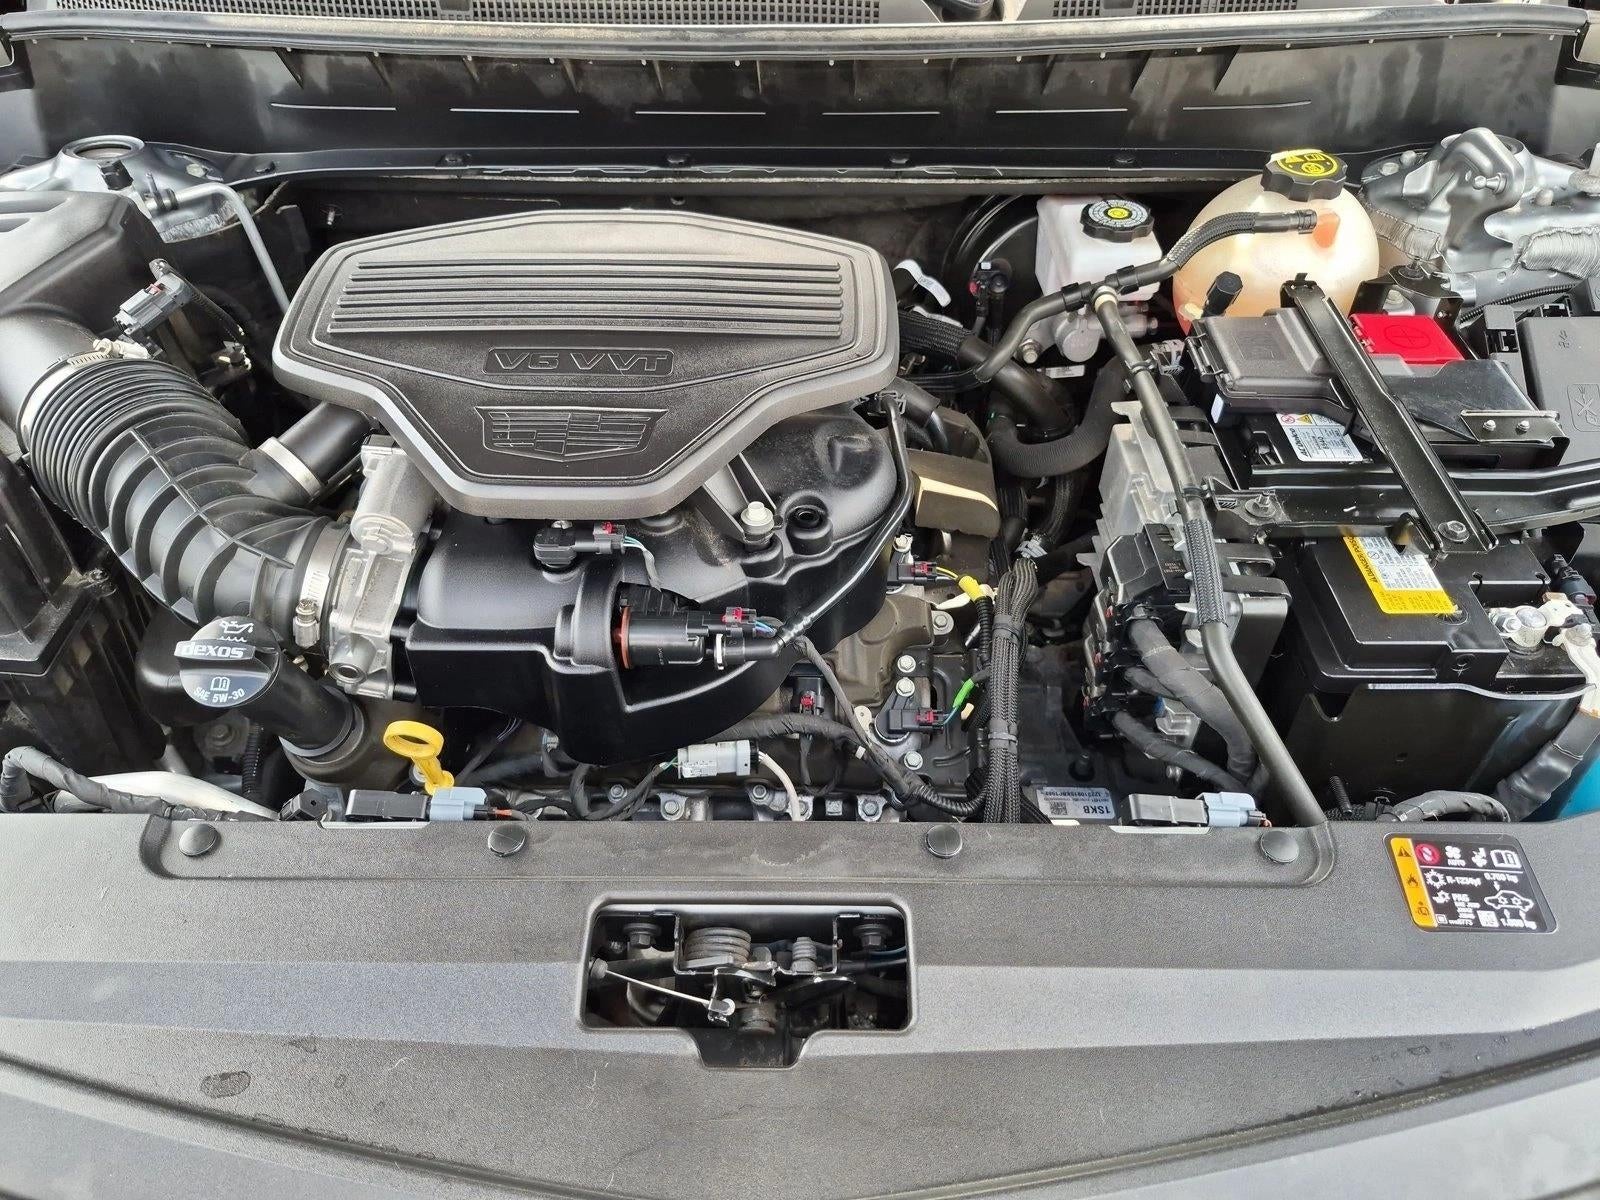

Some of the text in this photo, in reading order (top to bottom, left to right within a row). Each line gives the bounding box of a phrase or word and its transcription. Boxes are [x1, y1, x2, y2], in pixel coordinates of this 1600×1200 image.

[494, 352, 668, 372] V6 VVT
[181, 641, 247, 658] dexos
[193, 686, 246, 703] SAE 5W-30
[1083, 805, 1111, 814] 1SKB
